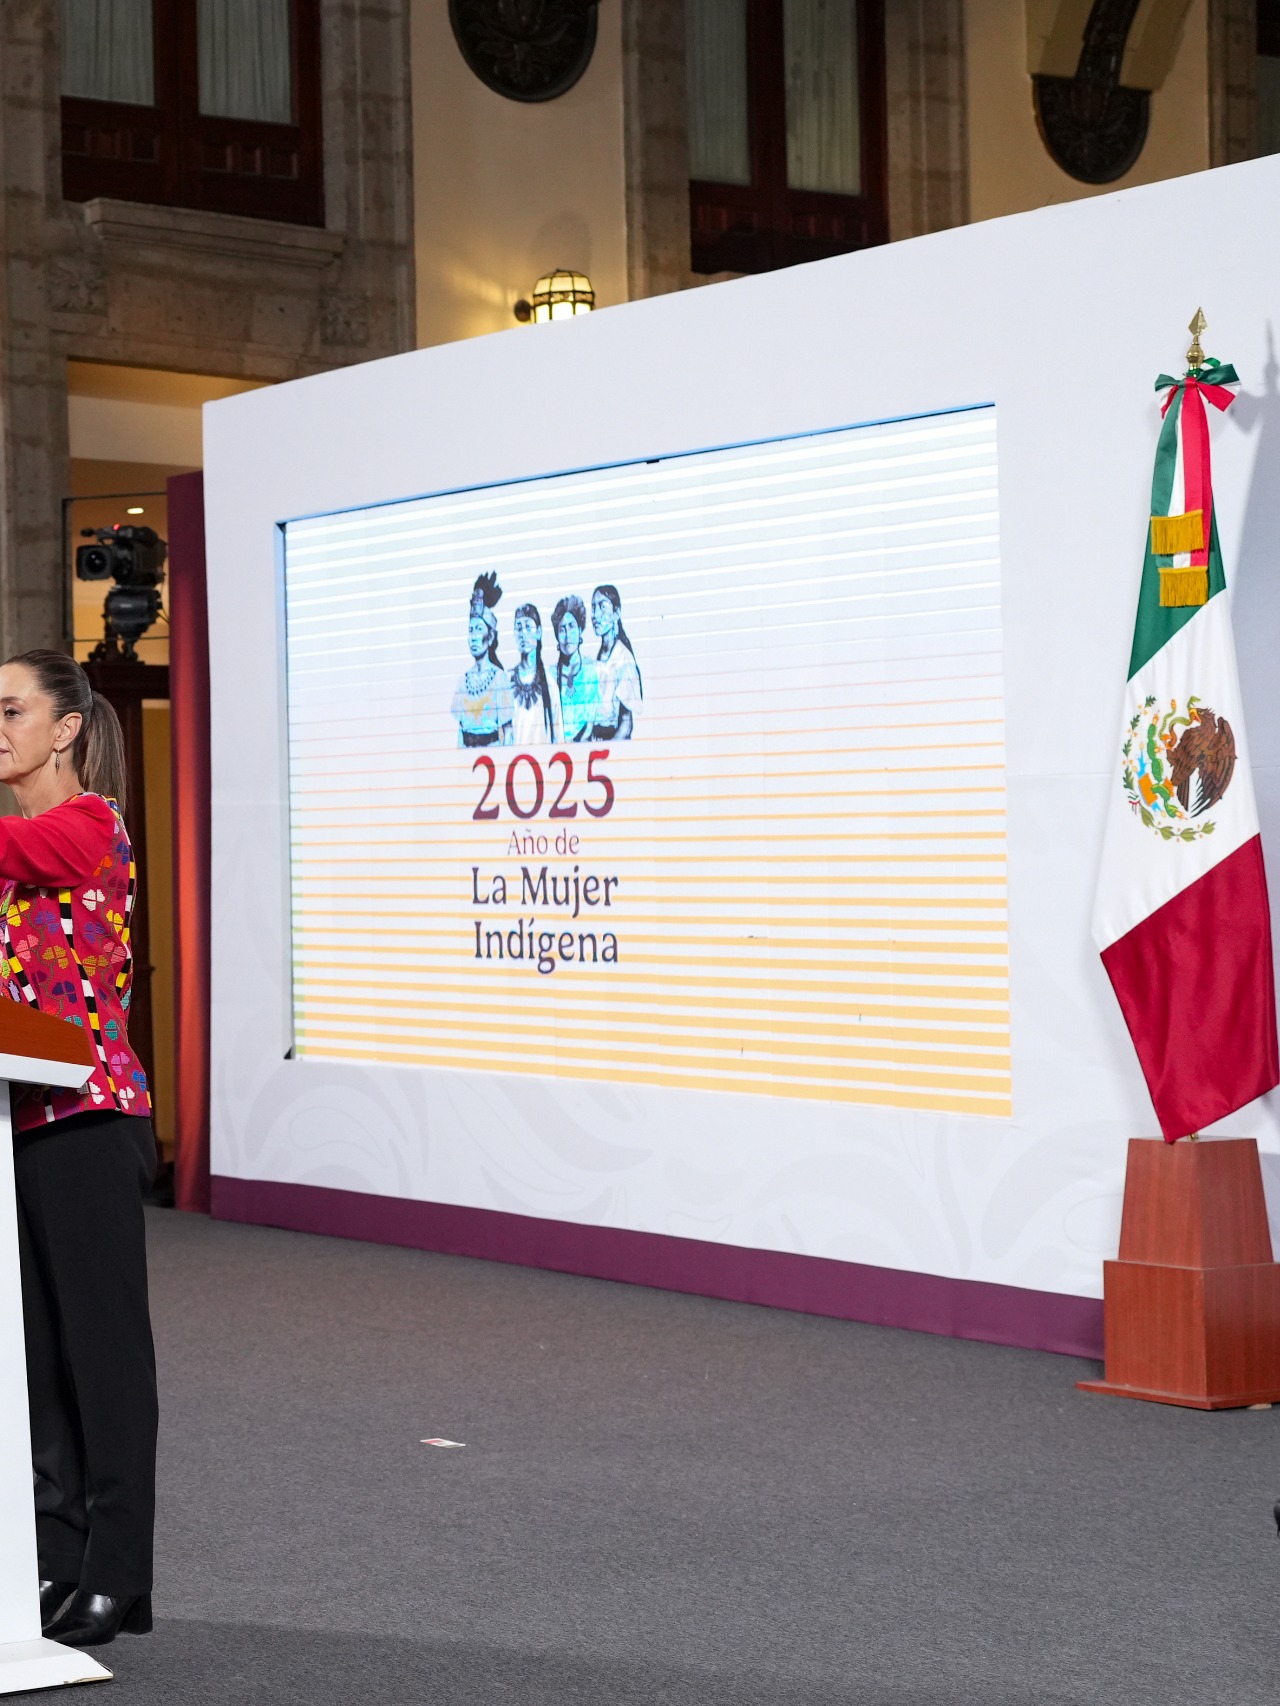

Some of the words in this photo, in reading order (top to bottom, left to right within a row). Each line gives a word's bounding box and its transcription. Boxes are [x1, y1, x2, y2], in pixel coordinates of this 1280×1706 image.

[472, 749, 615, 820] 2025
[507, 828, 549, 855] Año
[555, 828, 580, 855] de
[472, 867, 507, 905] La
[521, 865, 619, 918] Mujer
[474, 917, 618, 975] Indígena
